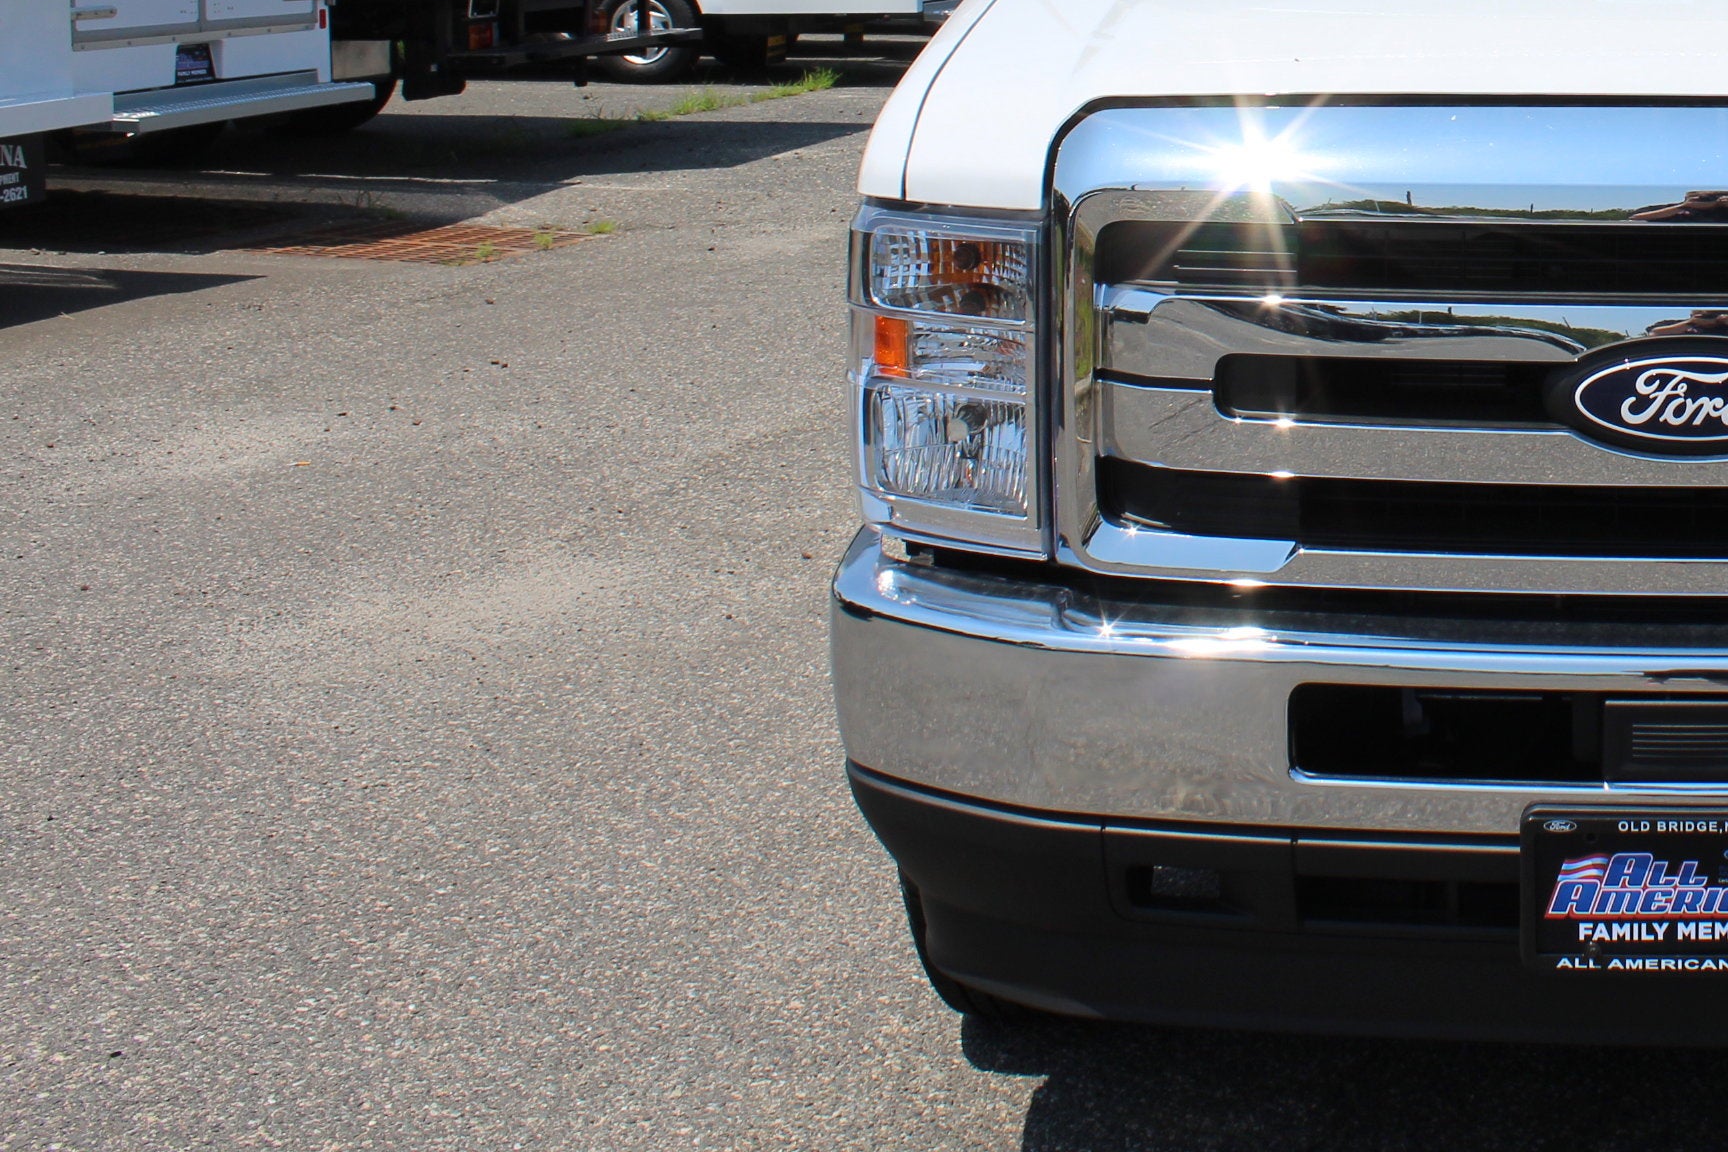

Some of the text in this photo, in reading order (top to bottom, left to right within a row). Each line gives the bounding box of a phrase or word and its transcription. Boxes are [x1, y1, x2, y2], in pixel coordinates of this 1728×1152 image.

[1549, 821, 1571, 832] Ford
[1618, 820, 1651, 833] OLD
[1578, 922, 1670, 942] FAMILY
[1555, 957, 1602, 969] ALL
